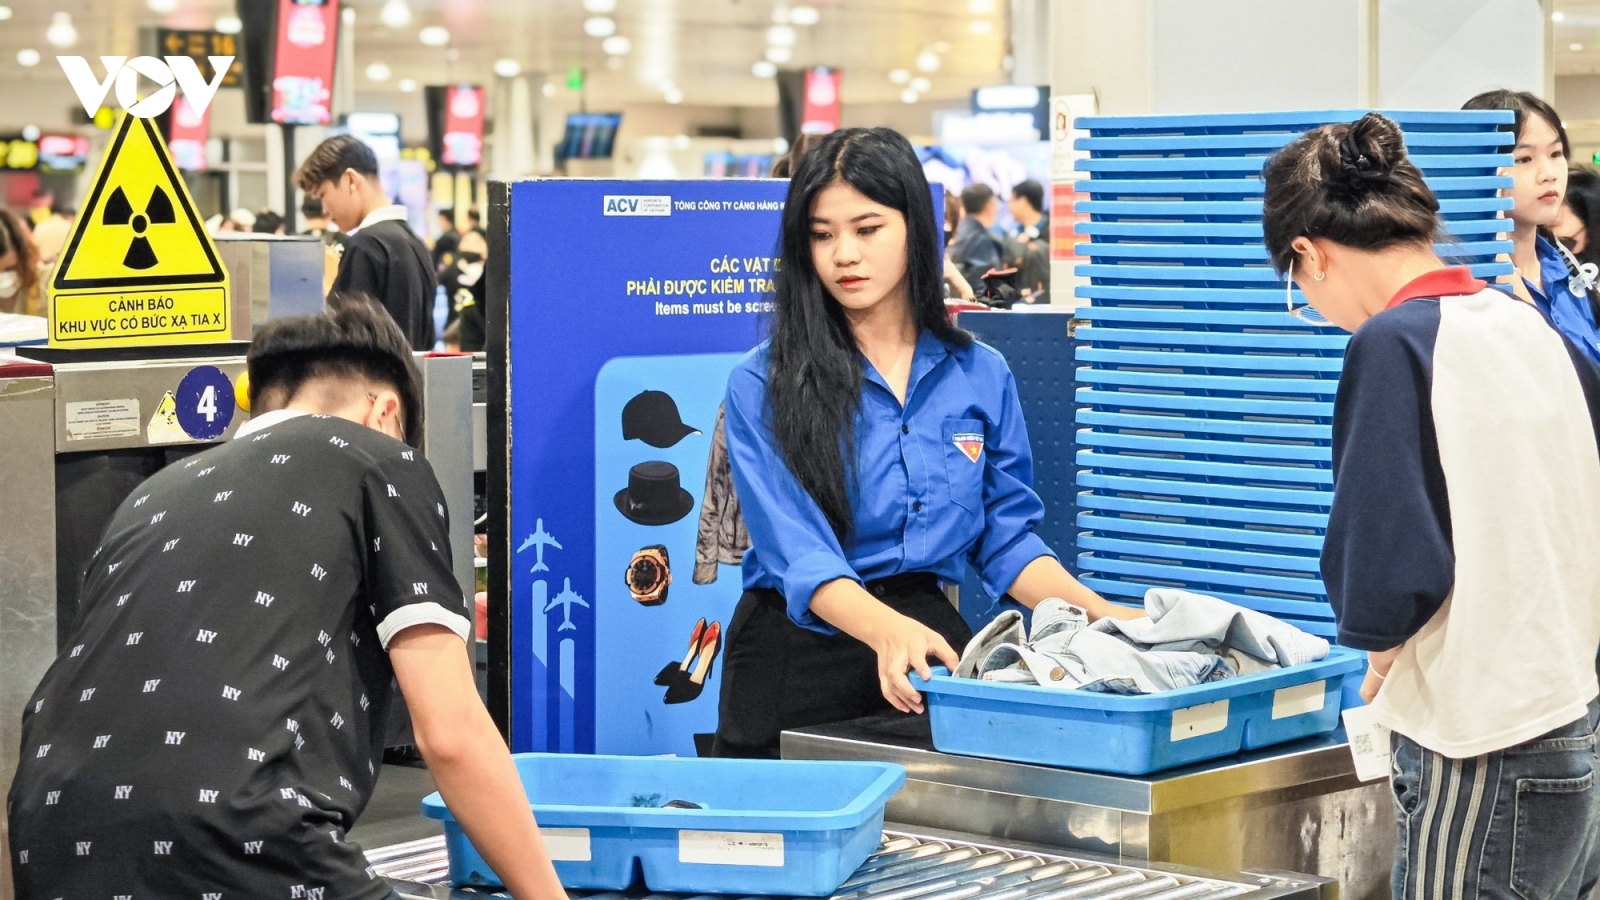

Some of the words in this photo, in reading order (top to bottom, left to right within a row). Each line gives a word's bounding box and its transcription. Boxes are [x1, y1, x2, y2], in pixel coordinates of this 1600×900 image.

[607, 198, 638, 213] ACV
[698, 199, 720, 210] CÔNG
[722, 201, 732, 210] TY
[710, 255, 739, 273] CÁC
[743, 256, 771, 276] VẬT
[626, 276, 660, 296] PHẢI
[664, 279, 707, 298] ĐƯỢC
[711, 276, 744, 294] KIỂM
[108, 296, 144, 313] CẢNH
[148, 296, 174, 310] BÁO
[655, 301, 689, 315] Items
[693, 301, 724, 315] must
[727, 300, 742, 314] be
[59, 320, 86, 334] KHU
[90, 318, 116, 335] VỰC
[120, 315, 138, 330] CÓ
[141, 314, 168, 329] BỨC
[171, 315, 187, 330] XẠ
[191, 314, 210, 326] TIA
[213, 313, 221, 325] X
[197, 385, 217, 422] 4
[329, 435, 349, 449] NY
[270, 454, 291, 464] NY
[401, 450, 414, 461] NY
[197, 466, 215, 477] NY
[213, 490, 233, 504] NY
[387, 484, 400, 497] N
[134, 494, 150, 507] NY
[292, 501, 311, 517] NY
[150, 510, 167, 525] NY
[162, 538, 180, 552] NY
[233, 533, 254, 547] NY
[311, 563, 327, 581] NY
[177, 580, 196, 592] NY
[413, 582, 428, 595] NY
[255, 591, 275, 607] NY
[126, 632, 143, 645] NY
[196, 629, 218, 643] NY
[318, 630, 332, 647] NY
[70, 644, 84, 657] NY
[272, 654, 289, 671] NY
[142, 679, 161, 692] NY
[80, 688, 96, 701] NY
[222, 685, 242, 701] NY
[330, 712, 344, 729] NY
[93, 735, 111, 748] NY
[165, 731, 186, 745] NY
[36, 744, 51, 758] NY
[248, 748, 266, 762] NY
[46, 791, 61, 805] NY
[115, 786, 133, 799] NY
[199, 789, 219, 803] NY
[76, 842, 92, 855] NY
[154, 841, 173, 854] NY
[244, 841, 263, 854] NY
[306, 887, 324, 900] NY
